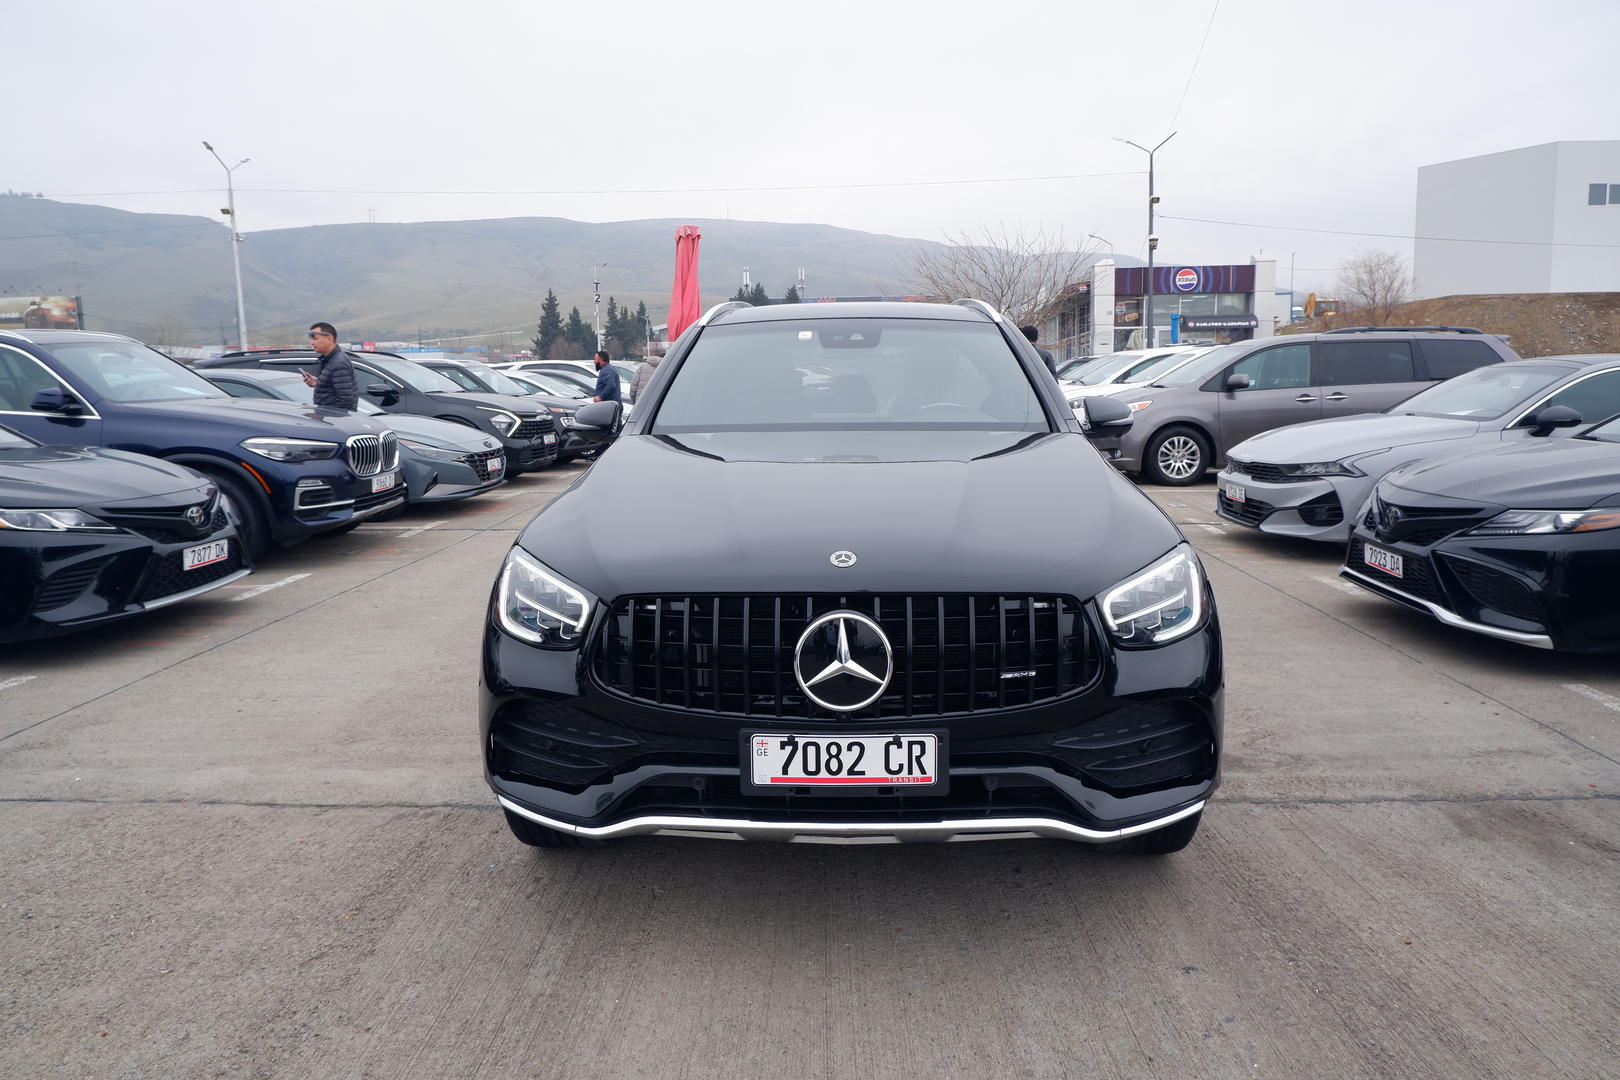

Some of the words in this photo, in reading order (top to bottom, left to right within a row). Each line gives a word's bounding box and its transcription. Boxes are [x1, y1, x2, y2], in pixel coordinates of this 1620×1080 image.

[593, 281, 601, 291] T
[594, 293, 601, 303] 2
[191, 545, 212, 564] 7877
[215, 541, 226, 557] DK
[1369, 547, 1387, 568] 7923
[1390, 555, 1401, 573] DA
[756, 748, 769, 757] GE
[779, 740, 866, 776] 7082
[884, 739, 927, 776] CR
[888, 776, 921, 784] TRANSIT
